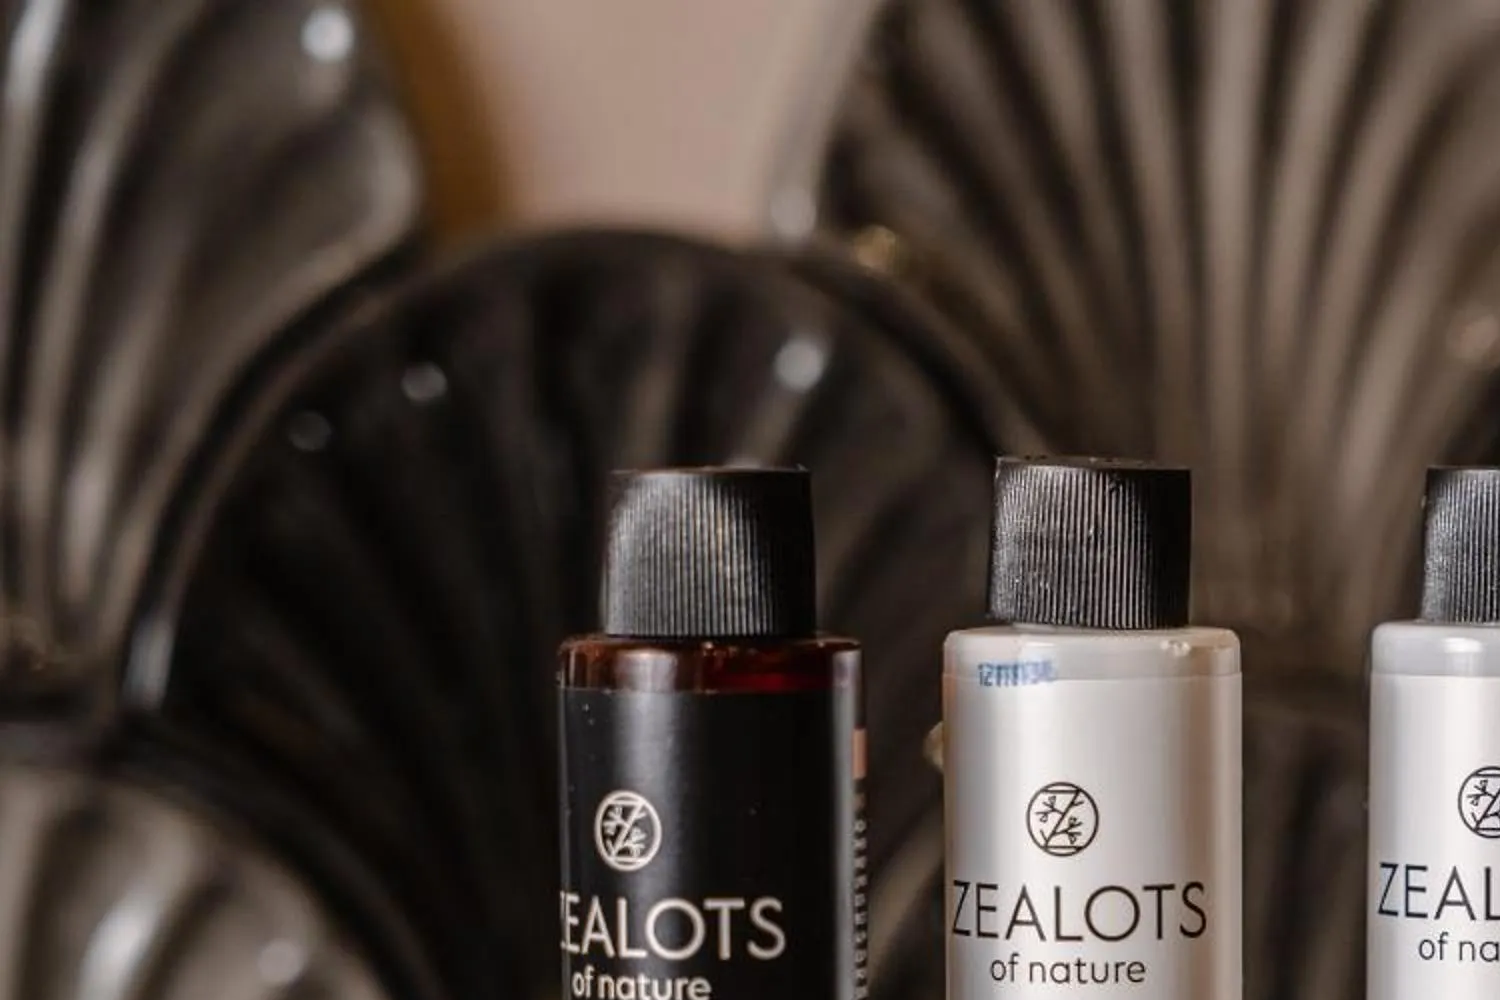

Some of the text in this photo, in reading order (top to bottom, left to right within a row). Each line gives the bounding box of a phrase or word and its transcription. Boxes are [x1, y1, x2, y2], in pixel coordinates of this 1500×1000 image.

[560, 890, 786, 961] EALOTS
[952, 879, 1208, 942] ZEALOTS
[1418, 931, 1449, 961] of
[572, 965, 594, 999] of
[990, 952, 1147, 985] of nature
